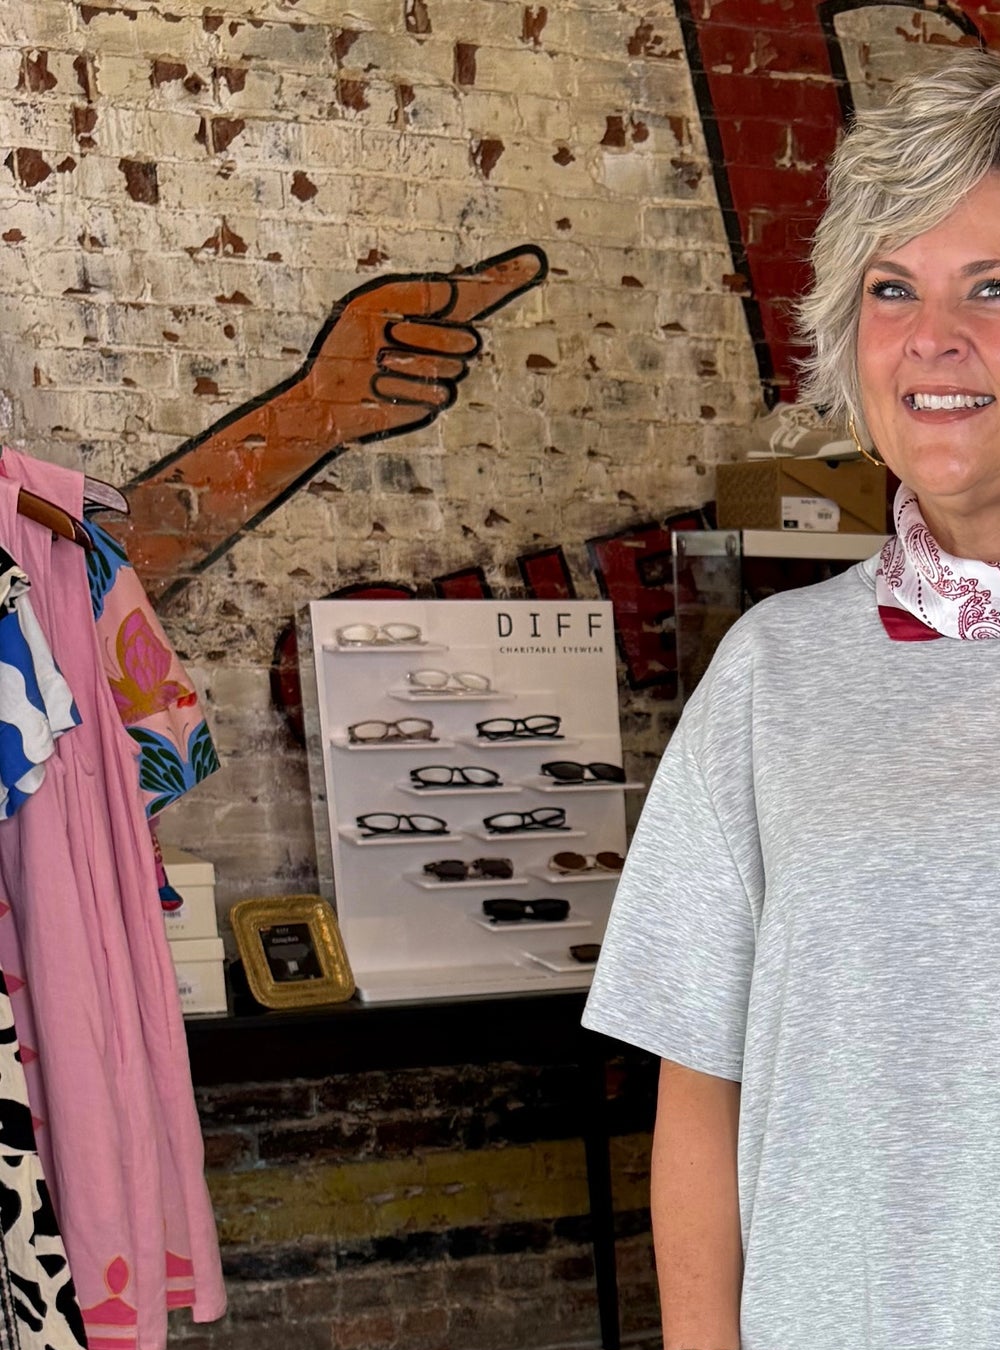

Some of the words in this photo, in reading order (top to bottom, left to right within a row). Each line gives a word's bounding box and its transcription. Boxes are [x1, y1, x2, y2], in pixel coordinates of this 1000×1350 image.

[497, 612, 603, 638] DIFF
[499, 645, 557, 655] CHARITABLE
[562, 645, 604, 654] EYEWEAR
